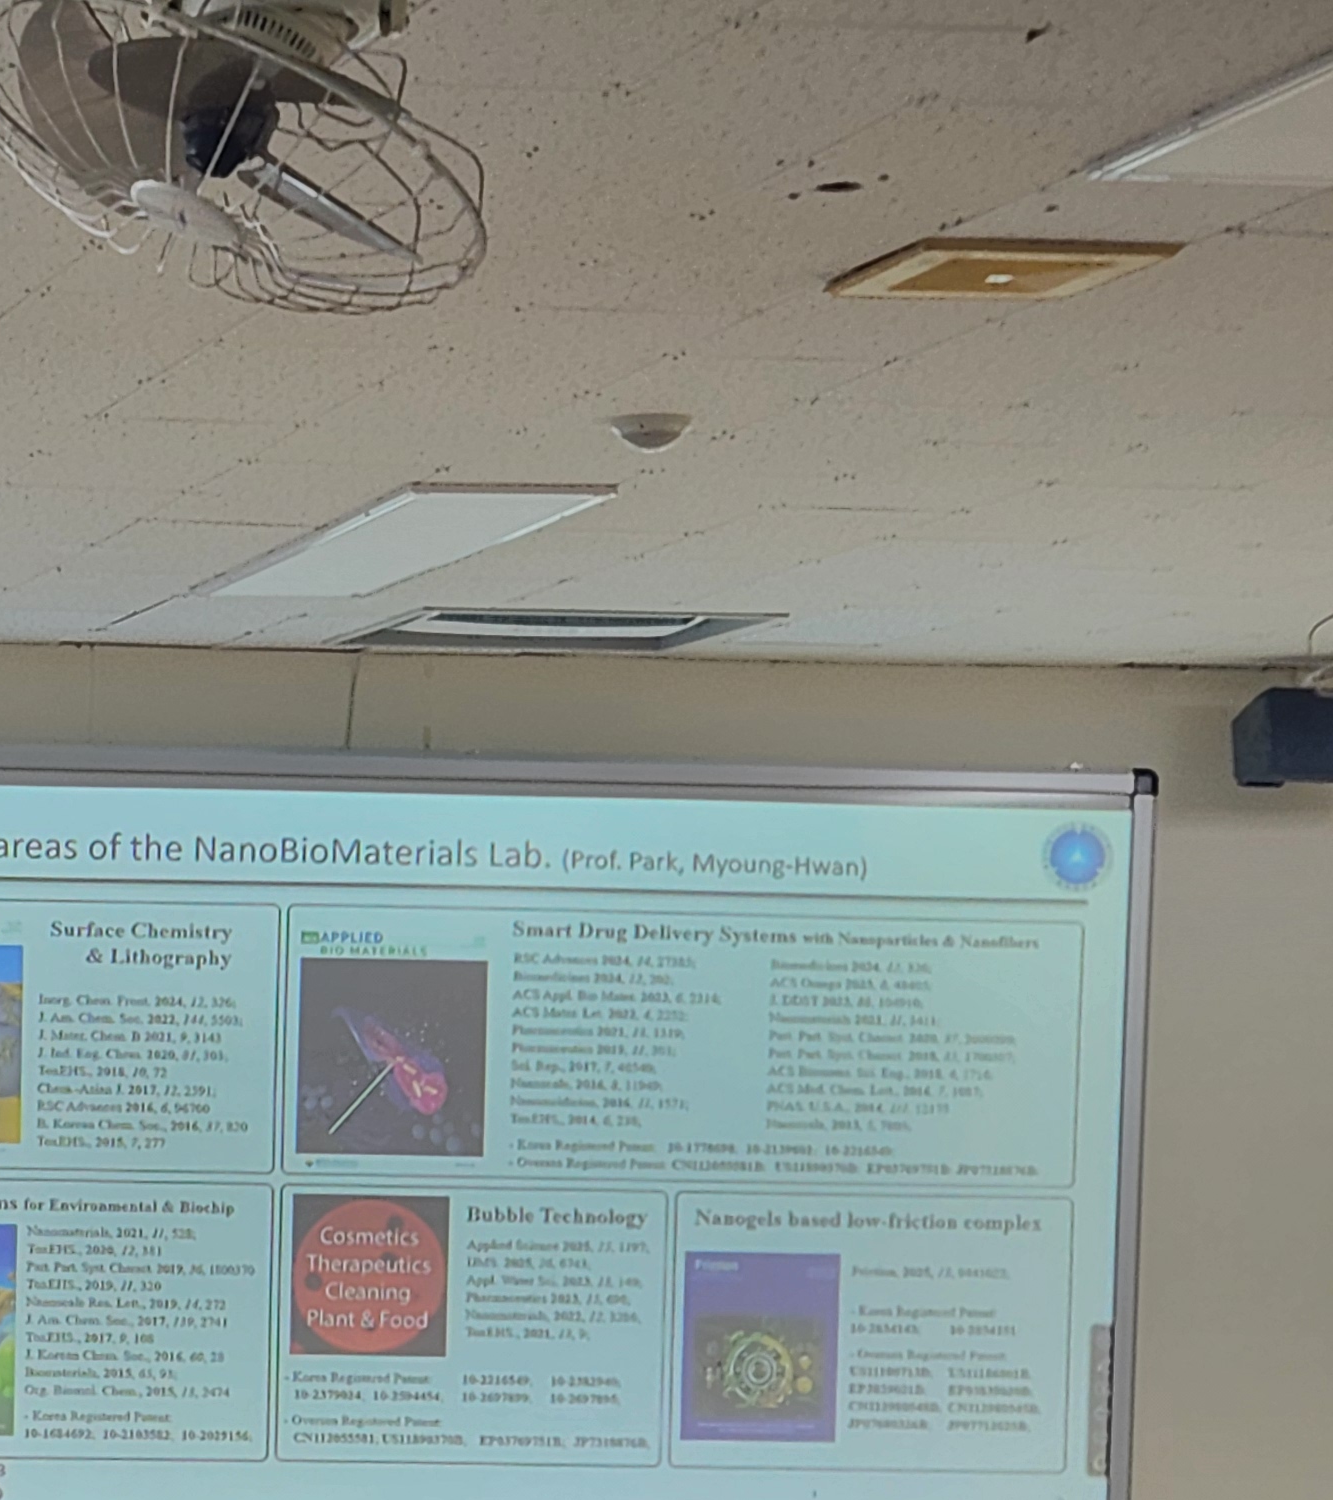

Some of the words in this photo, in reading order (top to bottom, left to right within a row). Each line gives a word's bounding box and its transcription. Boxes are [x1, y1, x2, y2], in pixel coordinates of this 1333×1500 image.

[88, 832, 122, 861] of
[130, 833, 183, 862] the
[194, 836, 478, 867] NanoBioMaterials
[489, 840, 552, 868] Lab.
[562, 849, 622, 875] (Prof.
[630, 851, 685, 876] Park,
[692, 853, 869, 879] Myoung-Hwan)
[50, 920, 125, 940] Surface
[132, 923, 232, 945] Chemistry
[321, 931, 383, 944] APPLIED
[512, 921, 571, 938] Smart
[578, 922, 628, 943] Drug
[633, 924, 714, 947] Delivery
[719, 926, 797, 947] Systems
[86, 948, 103, 965] &
[110, 948, 232, 970] Lithography
[24, 1199, 45, 1212] for
[49, 1200, 158, 1214] Environmental
[179, 1201, 235, 1218] Biochip
[467, 1206, 534, 1223] Bubble
[540, 1207, 648, 1229] Technology
[694, 1208, 782, 1230] Nanogels
[789, 1211, 841, 1228] based
[847, 1212, 958, 1231] low-friction
[963, 1214, 1042, 1236] complex
[320, 1226, 419, 1246] Cosmetics
[307, 1254, 432, 1276] Therapeutics
[325, 1282, 411, 1305] Cleaning
[307, 1309, 355, 1328] Plant
[361, 1310, 375, 1328] &
[380, 1311, 429, 1329] Food
